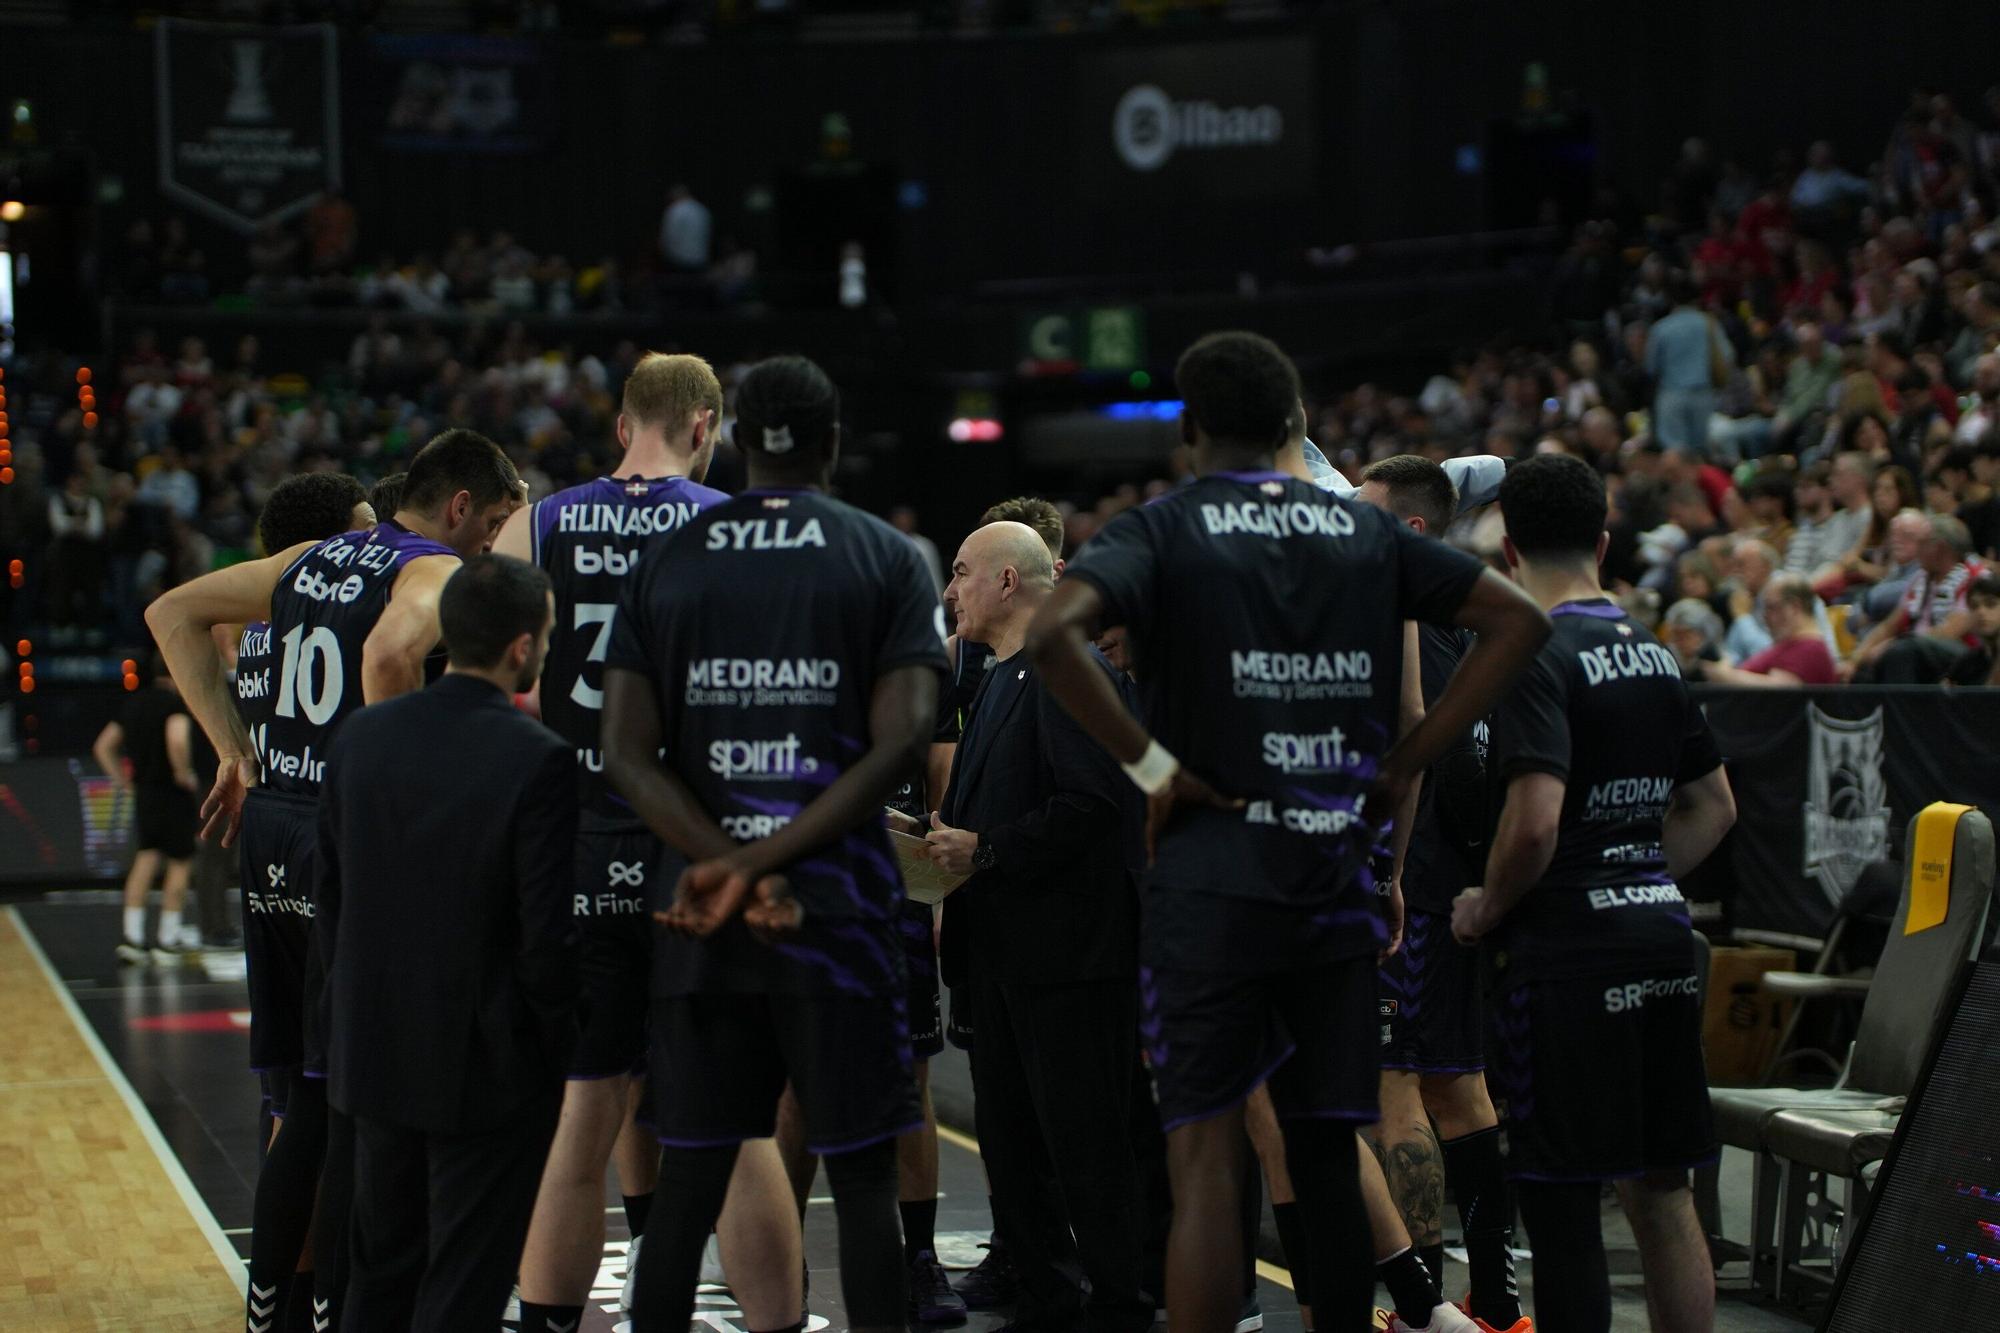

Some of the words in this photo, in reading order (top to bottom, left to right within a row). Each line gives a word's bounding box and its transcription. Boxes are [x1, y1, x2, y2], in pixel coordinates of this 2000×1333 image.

[705, 518, 827, 551] SYLLA
[275, 622, 344, 726] 10
[686, 658, 841, 689] MEDRANO
[1231, 650, 1373, 682] MEDRANO
[1578, 646, 1619, 688] DE
[1587, 886, 1628, 911] EL
